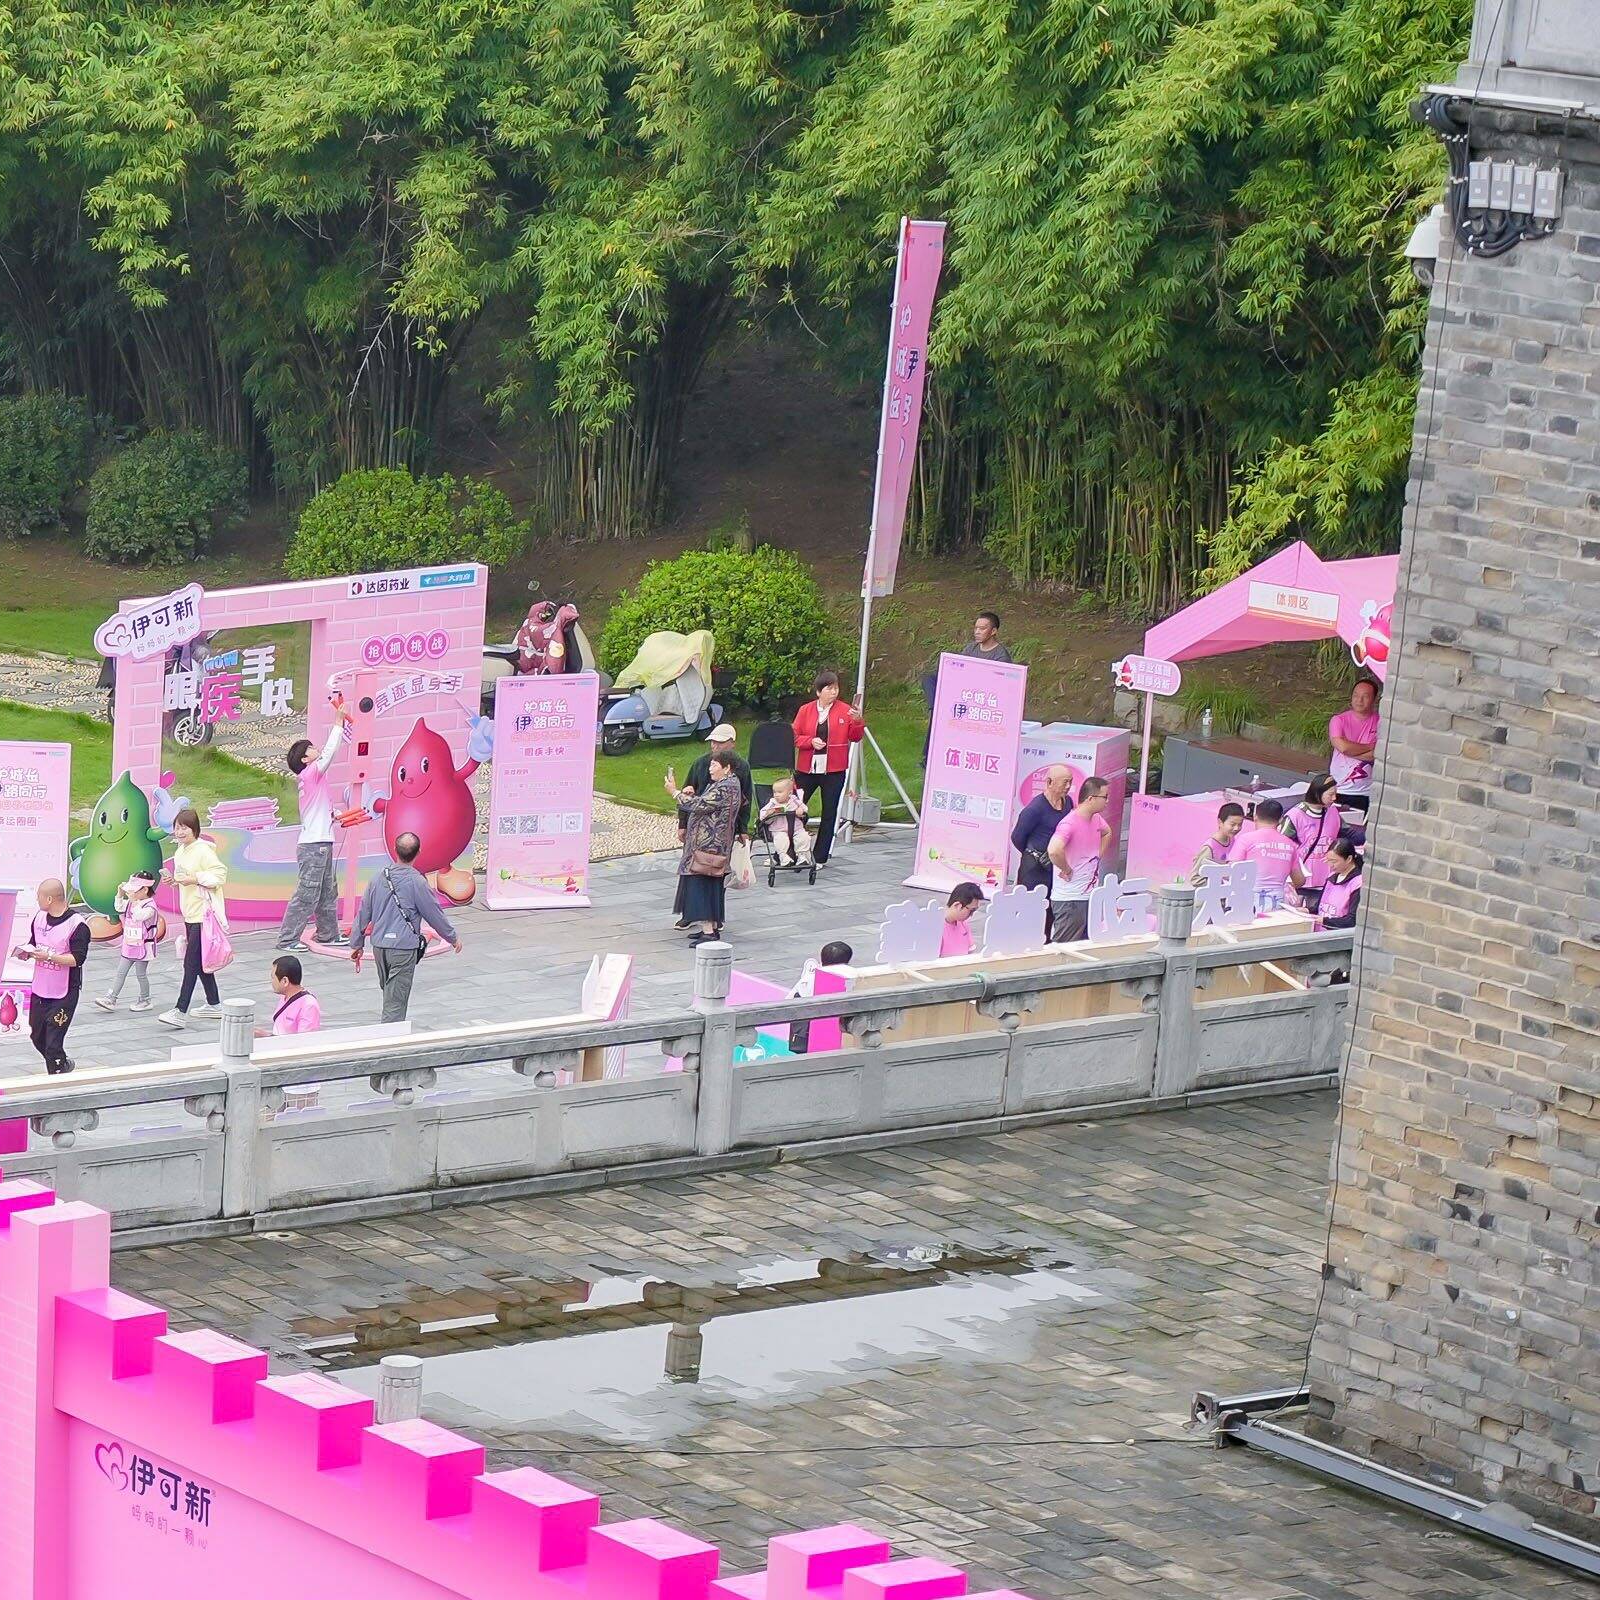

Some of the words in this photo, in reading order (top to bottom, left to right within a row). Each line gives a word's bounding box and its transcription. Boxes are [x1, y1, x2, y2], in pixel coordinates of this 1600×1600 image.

[366, 577, 410, 595] 达因药业
[1275, 591, 1311, 610] 体测区
[131, 595, 194, 640] 伊可新
[523, 699, 568, 713] 护城长
[952, 702, 1004, 725] 伊路同行
[514, 715, 576, 732] 伊路同行
[945, 747, 1001, 775] 体测区
[130, 1454, 213, 1528] 伊可新
[131, 1503, 209, 1551] 妈妈的一颗心
